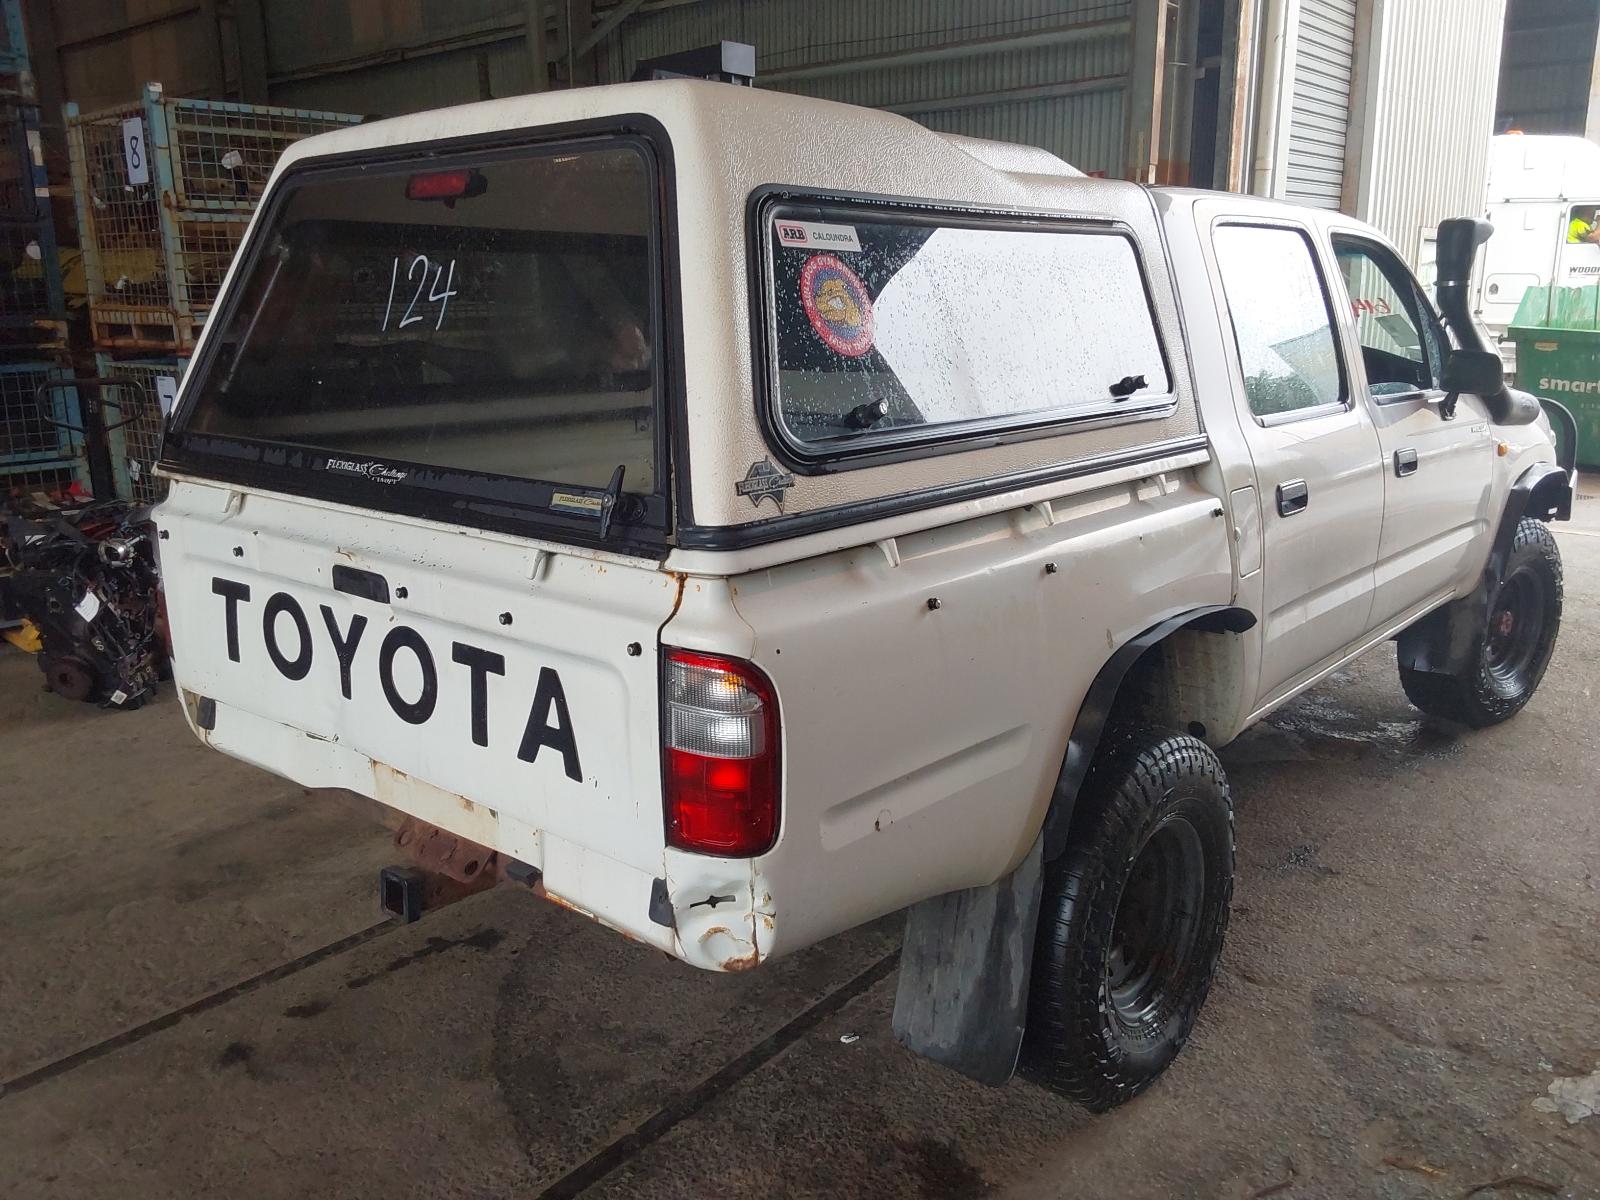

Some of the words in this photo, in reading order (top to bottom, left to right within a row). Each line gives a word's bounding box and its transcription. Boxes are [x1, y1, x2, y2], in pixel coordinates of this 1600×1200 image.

[129, 135, 141, 170] 8
[782, 227, 806, 240] ARB
[812, 231, 854, 242] CALOUNDRA
[381, 254, 458, 332] 124
[325, 458, 368, 473] FLEXIGLASS
[211, 577, 583, 783] TOYOTA
